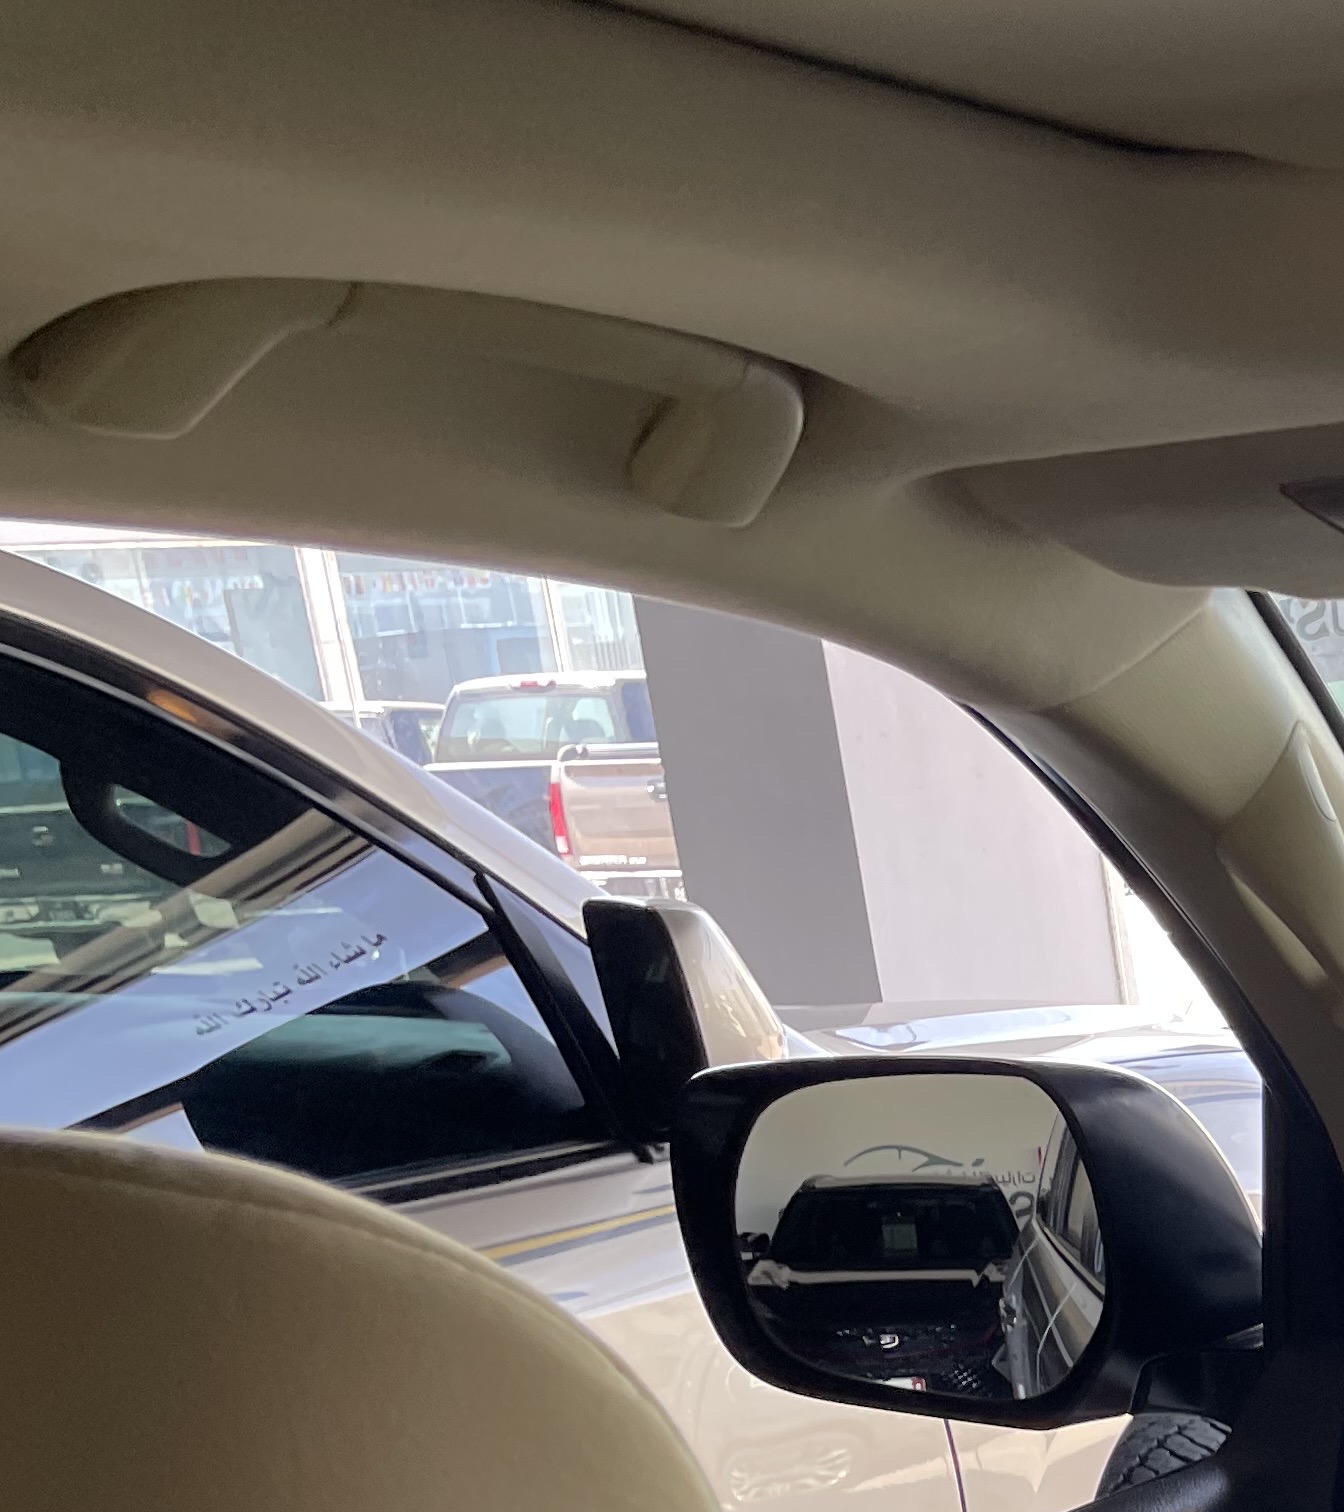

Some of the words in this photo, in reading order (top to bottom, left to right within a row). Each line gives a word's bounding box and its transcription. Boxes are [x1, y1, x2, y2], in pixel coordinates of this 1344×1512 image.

[328, 941, 368, 971] شاء
[293, 962, 329, 986] الله
[234, 980, 294, 1018] تبارك
